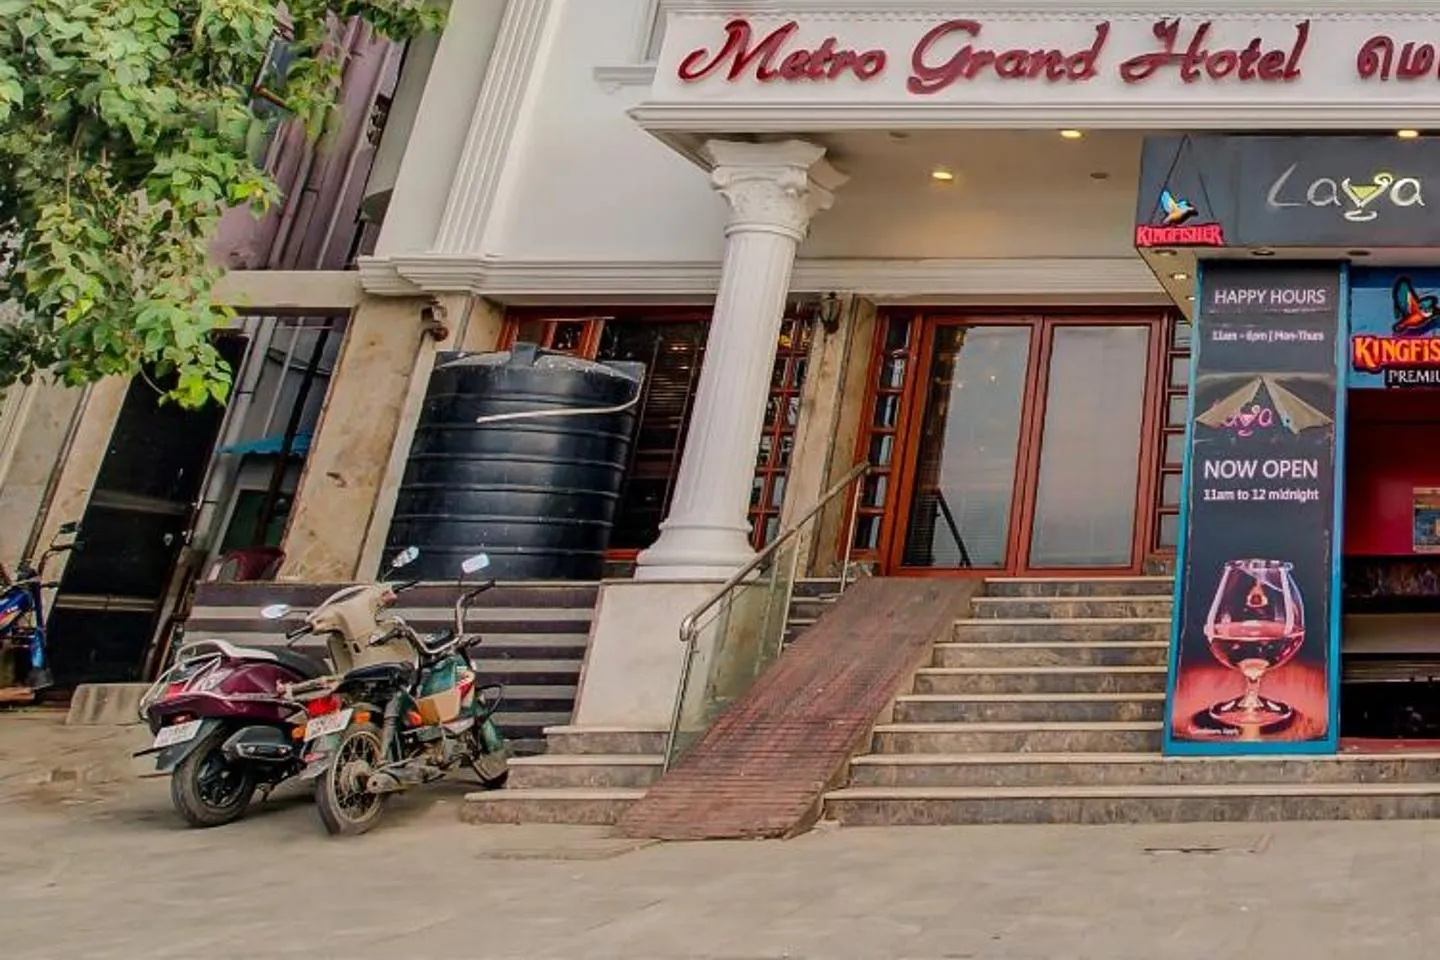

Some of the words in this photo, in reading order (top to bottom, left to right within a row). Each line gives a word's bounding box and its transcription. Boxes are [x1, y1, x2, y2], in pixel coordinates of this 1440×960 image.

[678, 18, 885, 83] Metro
[906, 18, 1111, 95] Grand
[1119, 16, 1310, 84] Hotel
[1136, 225, 1223, 246] KINGFISHER
[1214, 289, 1266, 304] HAPPY
[1270, 289, 1326, 304] HOURS
[1203, 459, 1257, 480] NOW
[1262, 458, 1319, 479] OPEN
[1203, 488, 1235, 501] 11am
[1237, 488, 1249, 501] to
[1251, 487, 1266, 500] 12
[1267, 487, 1320, 503] midnight
